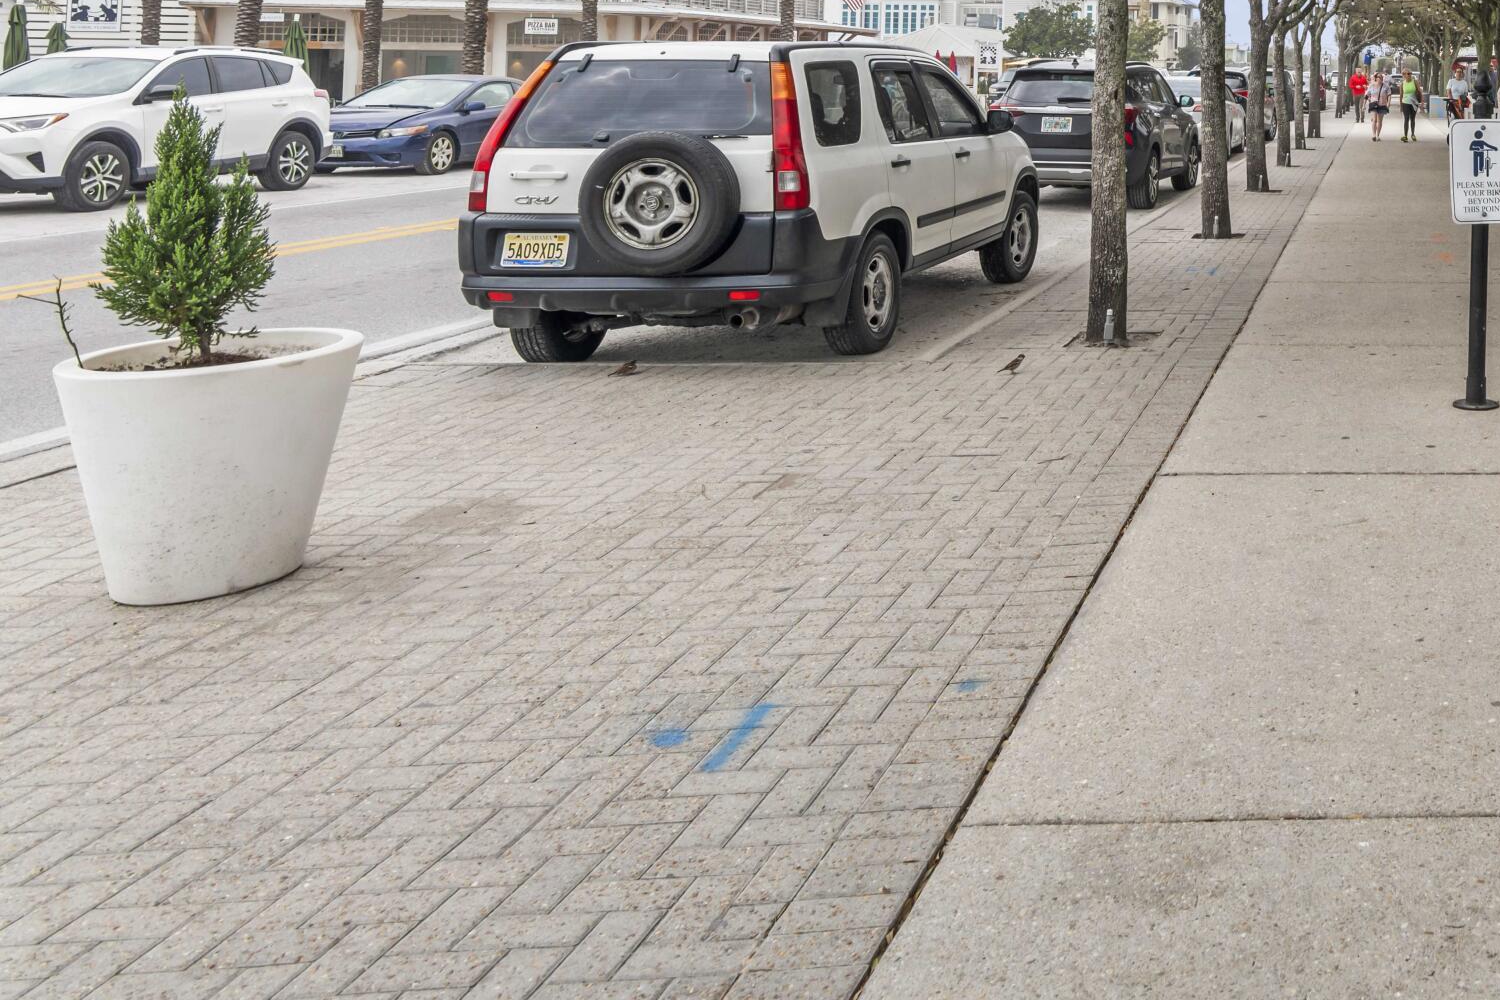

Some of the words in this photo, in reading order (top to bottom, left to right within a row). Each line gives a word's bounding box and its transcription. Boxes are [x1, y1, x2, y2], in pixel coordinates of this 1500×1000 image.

[1456, 181, 1484, 189] PLEASE
[1467, 197, 1500, 205] BEYOND
[507, 242, 564, 259] 5A09XD5
